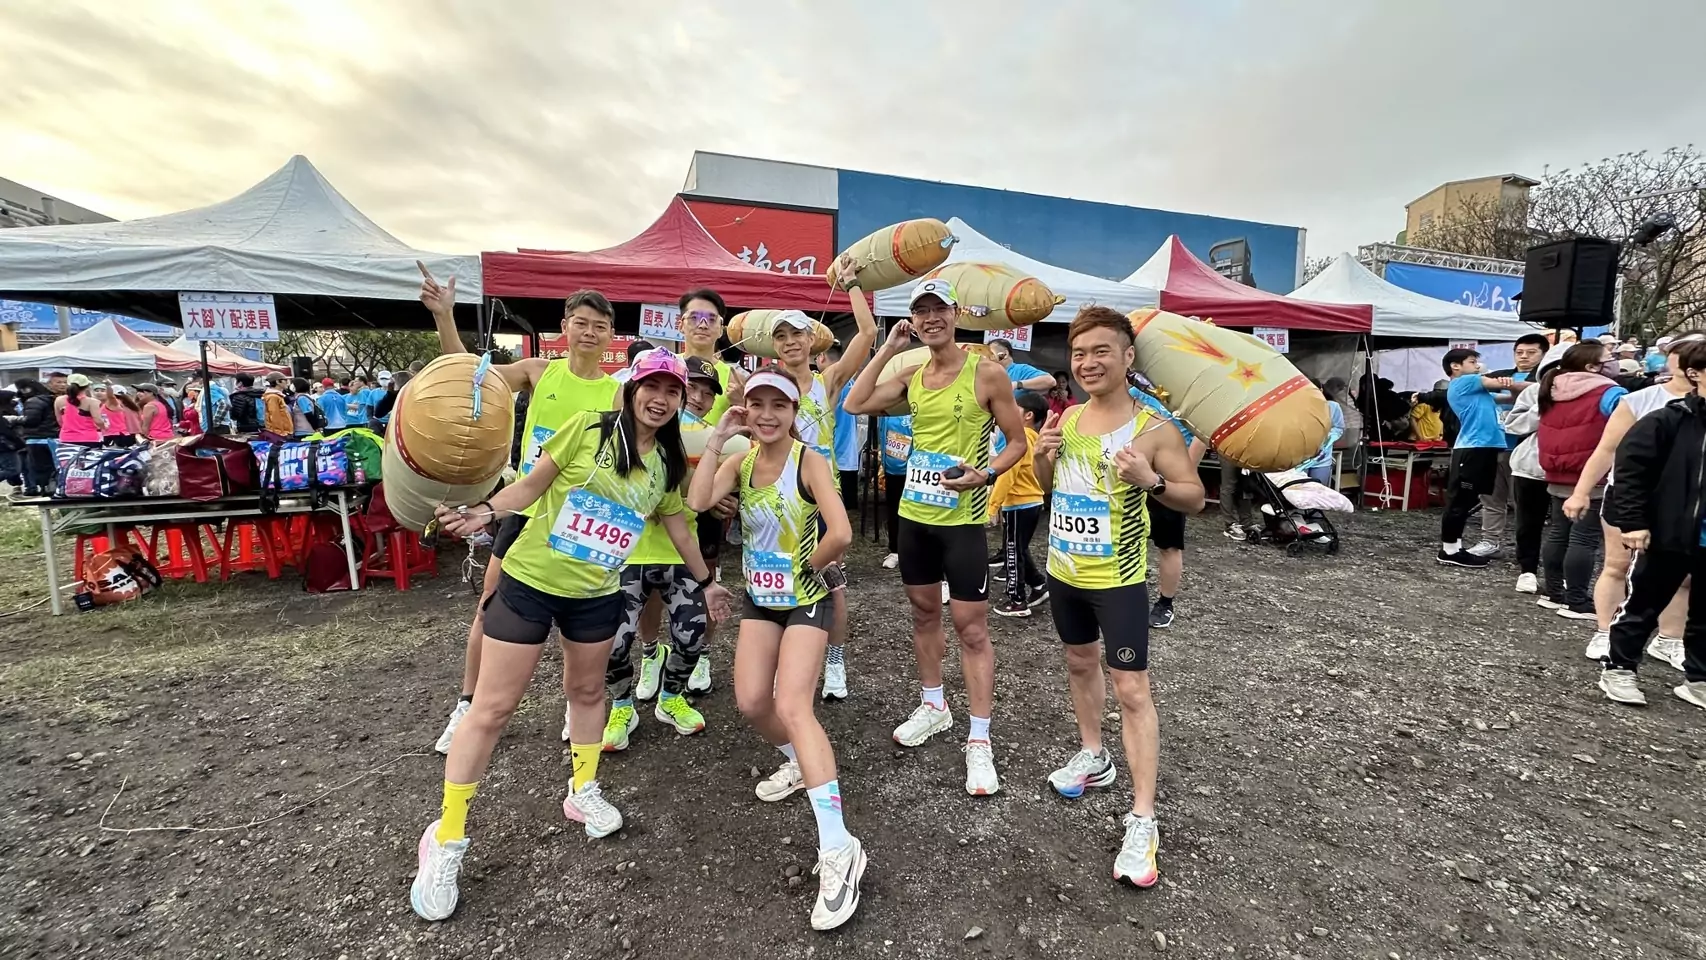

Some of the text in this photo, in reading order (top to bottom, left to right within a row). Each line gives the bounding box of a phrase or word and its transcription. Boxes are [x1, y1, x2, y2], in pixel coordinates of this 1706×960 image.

[187, 308, 271, 331] 大腳丫配速員
[599, 351, 627, 363] 迎參
[910, 468, 941, 487] 1149
[566, 513, 633, 549] 11496
[1053, 511, 1100, 535] 11503
